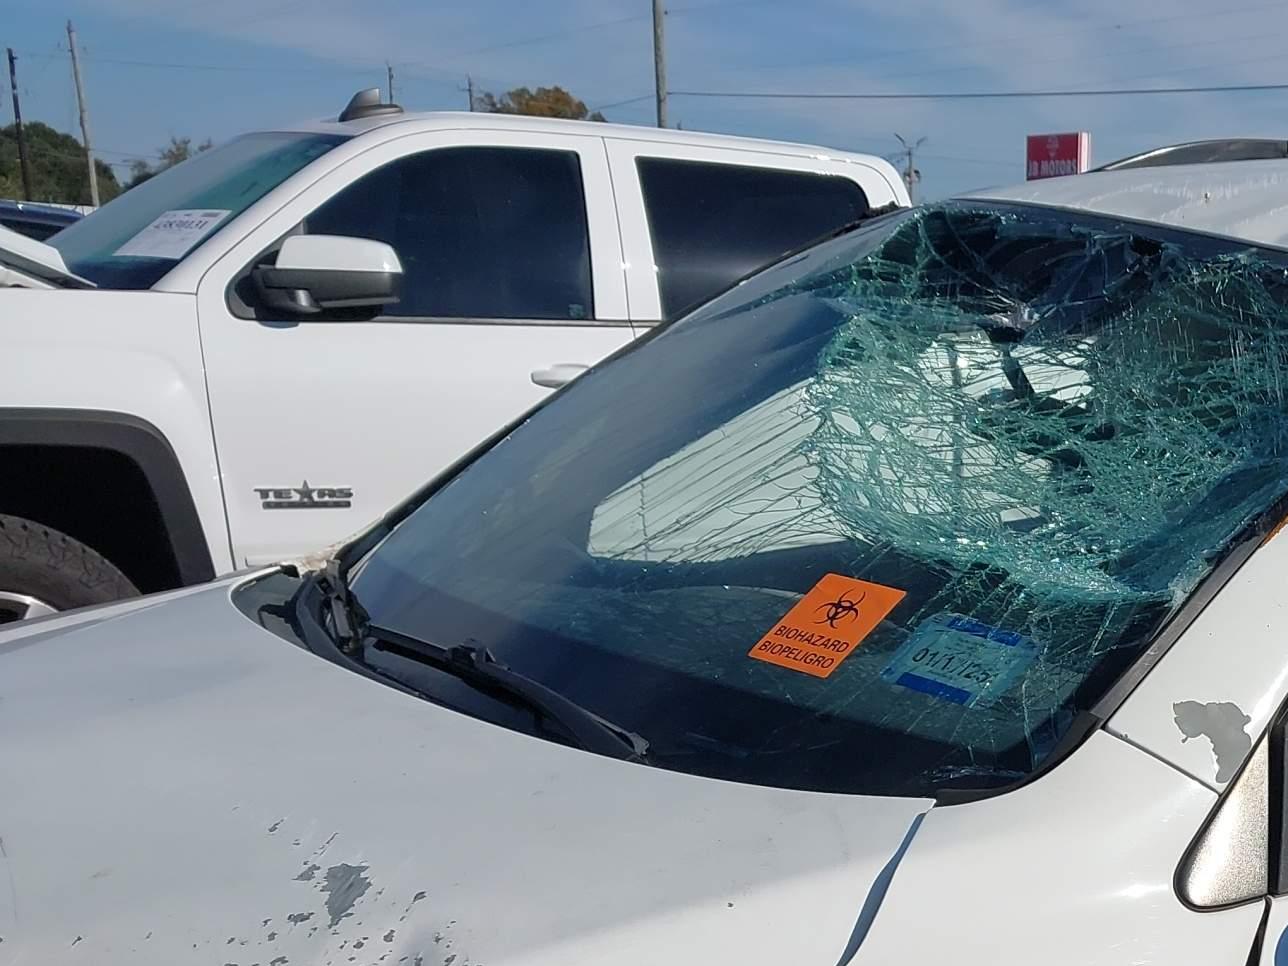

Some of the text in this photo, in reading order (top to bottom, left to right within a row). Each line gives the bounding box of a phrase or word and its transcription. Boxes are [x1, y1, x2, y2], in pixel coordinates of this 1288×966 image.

[1040, 159, 1077, 176] MOTORS
[774, 626, 850, 654] BIOHAZARD
[758, 641, 835, 669] BIOPELIGRO
